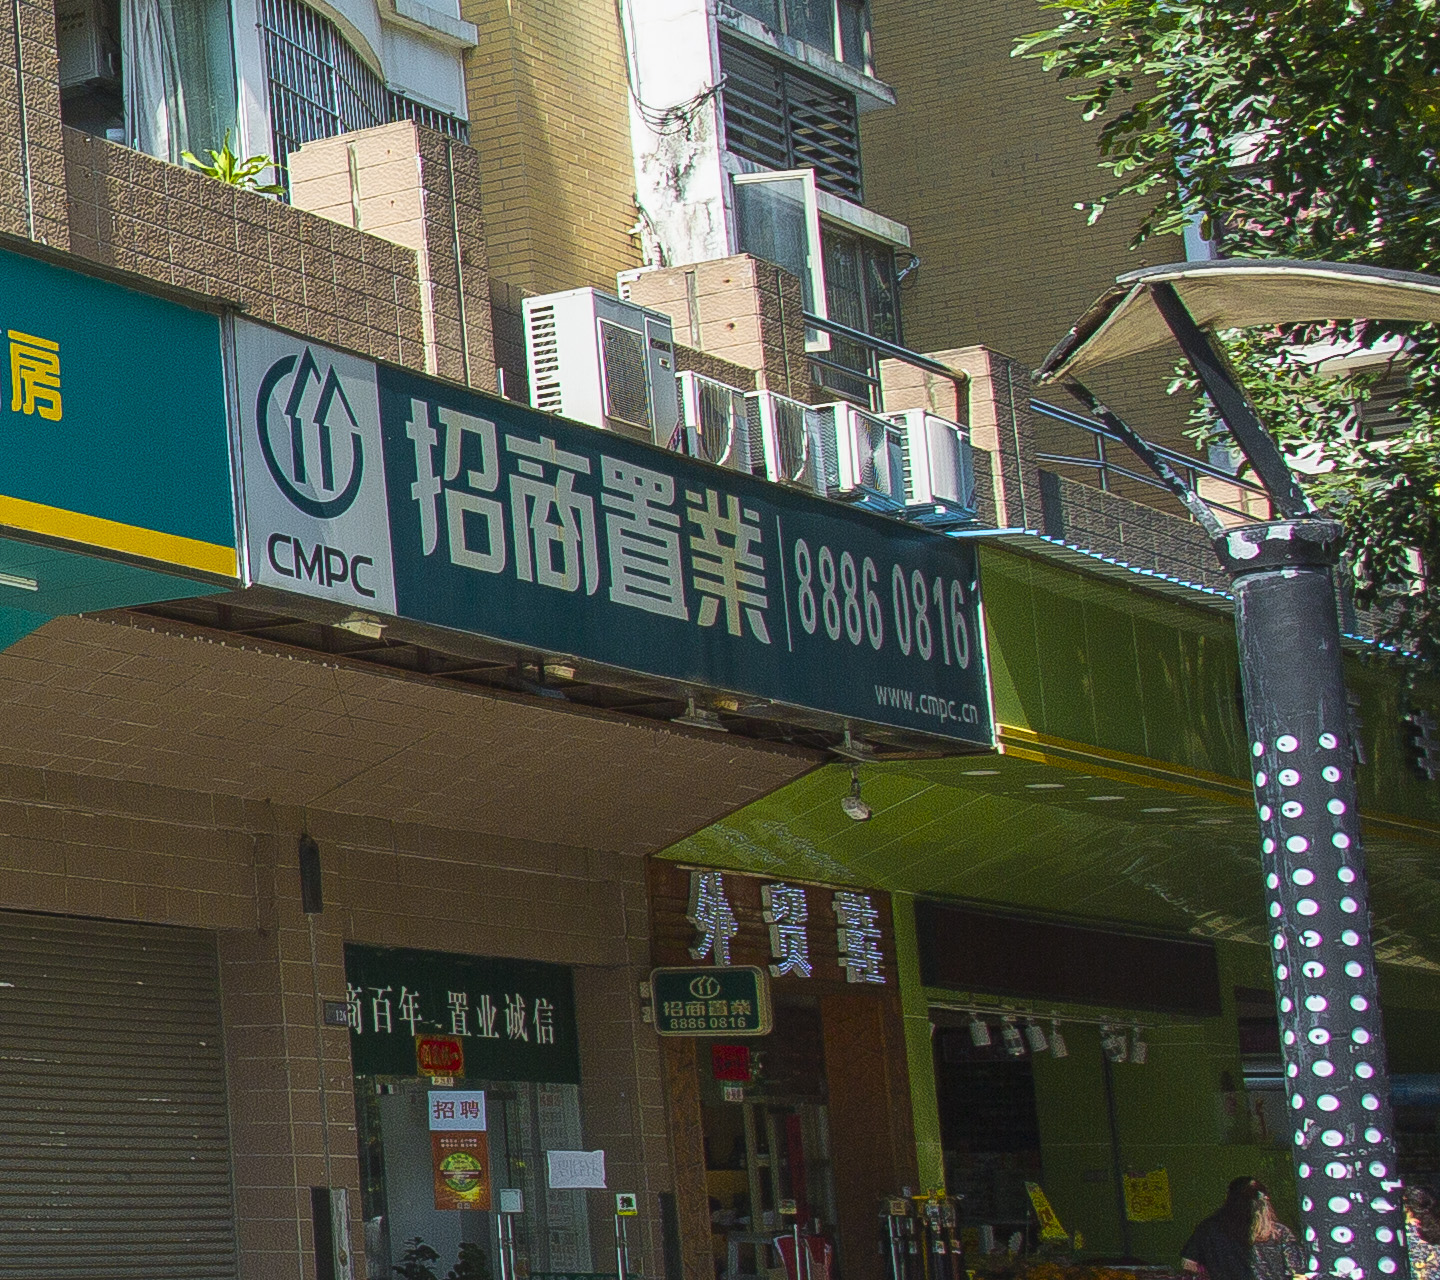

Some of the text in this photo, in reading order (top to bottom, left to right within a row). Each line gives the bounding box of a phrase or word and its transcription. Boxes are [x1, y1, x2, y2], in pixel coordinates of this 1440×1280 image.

[406, 398, 771, 646] 招商置業
[268, 532, 377, 599] CMPC
[794, 537, 971, 673] 8886 0816
[874, 683, 980, 725] www.cmpc.cn
[447, 990, 554, 1045] 置业诚信
[664, 999, 752, 1016] 招商置業
[710, 1017, 746, 1029] 0816
[433, 1100, 479, 1119] 招聘
